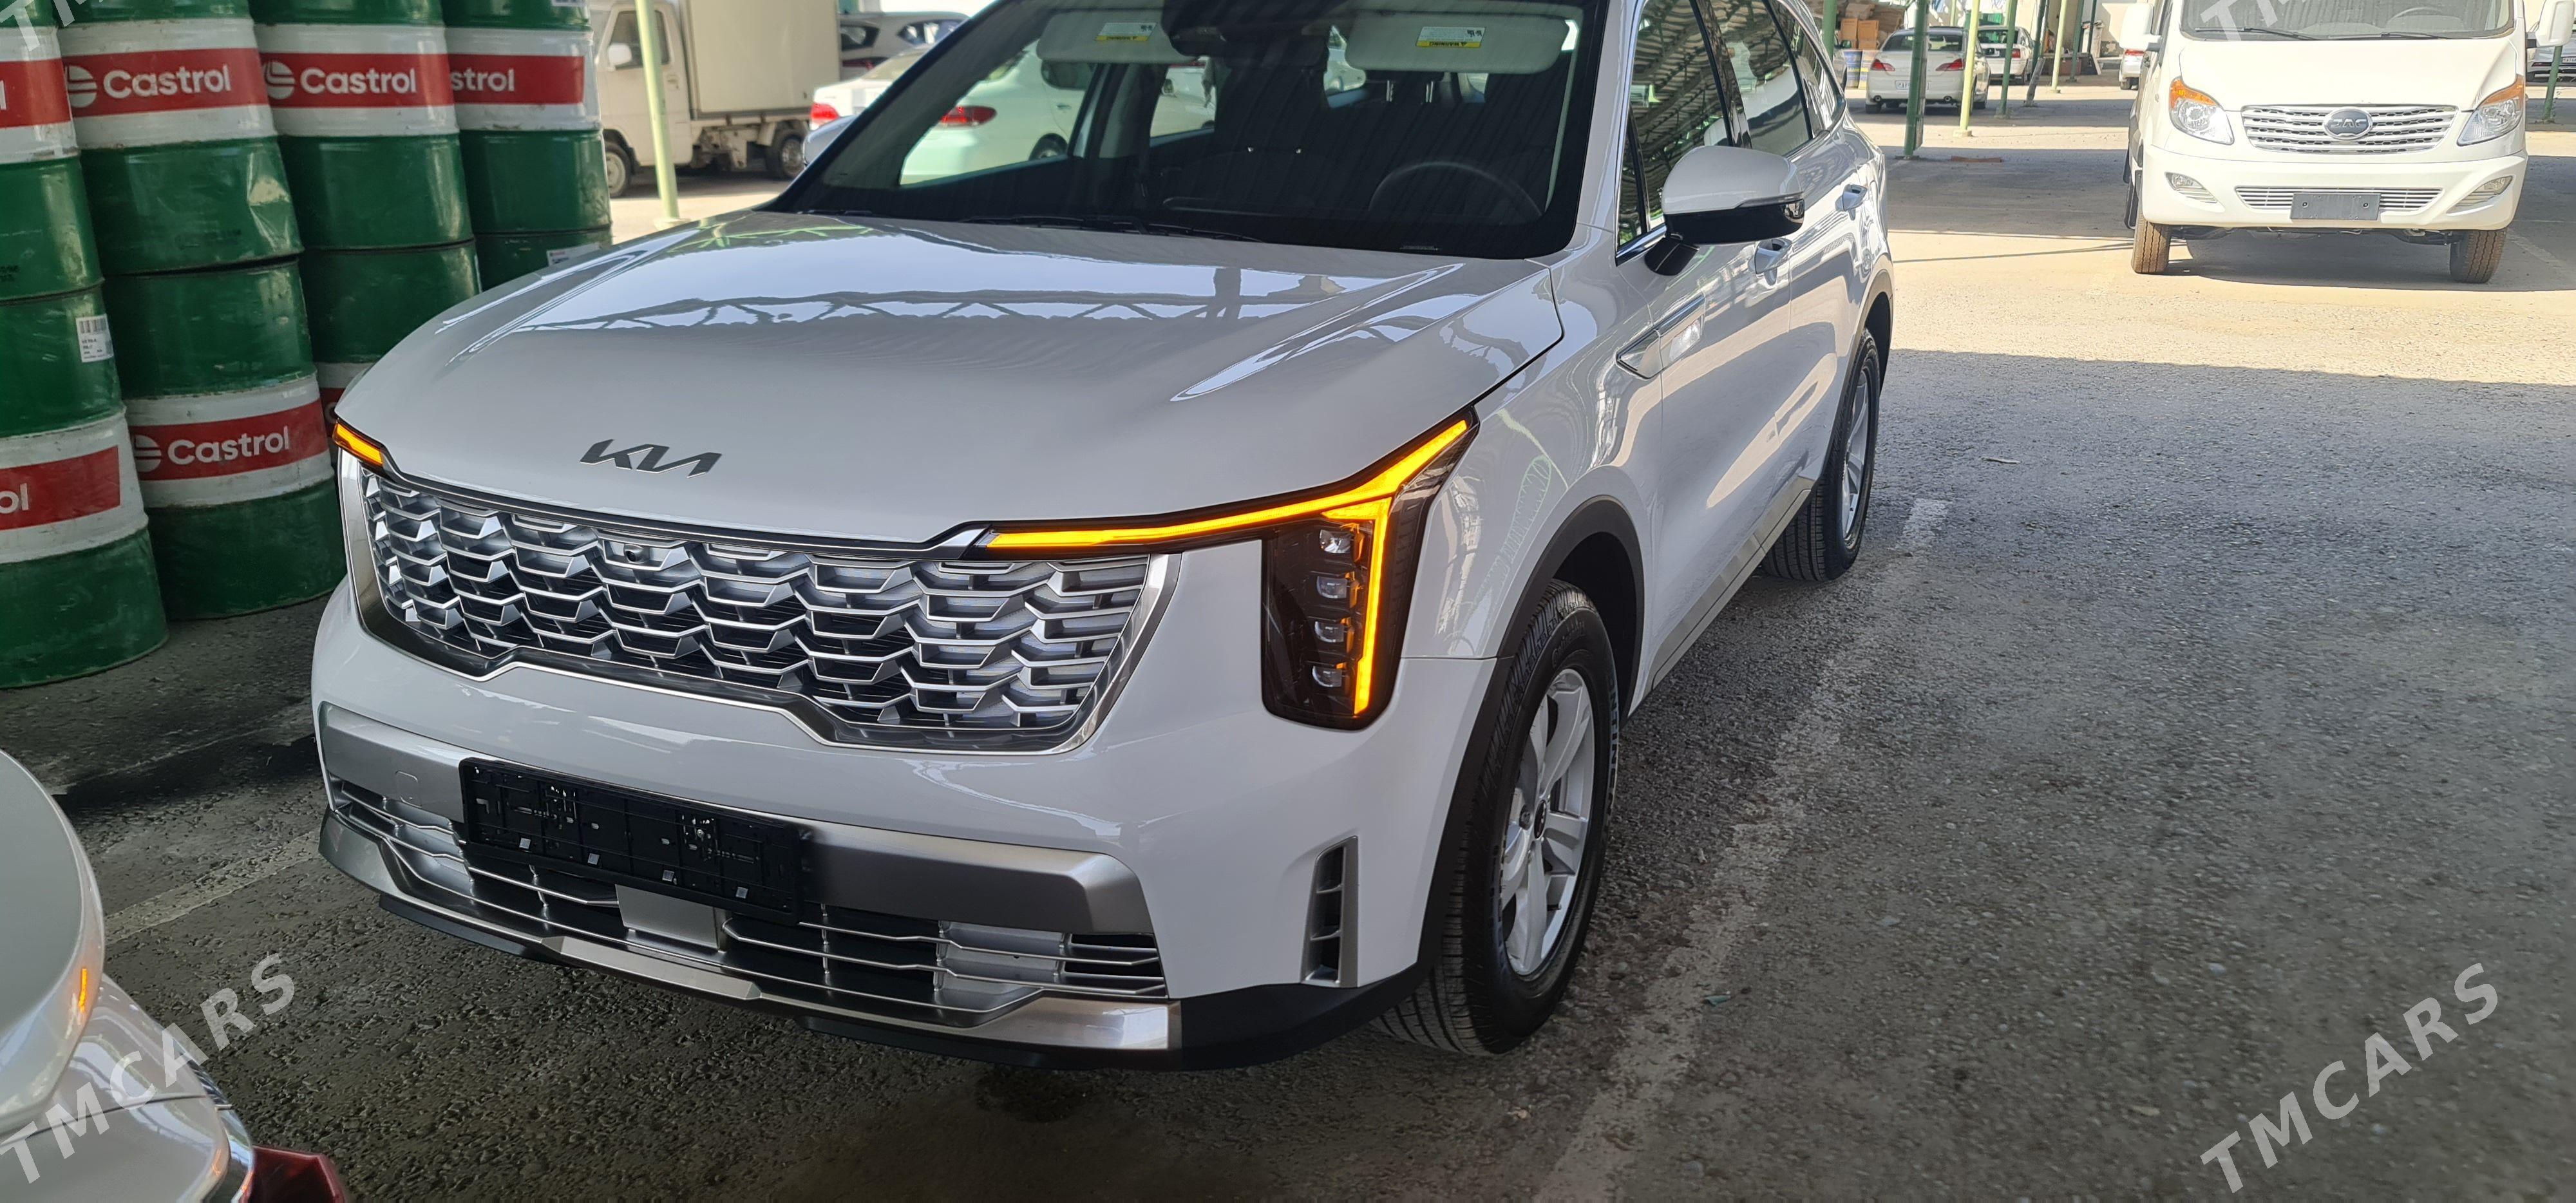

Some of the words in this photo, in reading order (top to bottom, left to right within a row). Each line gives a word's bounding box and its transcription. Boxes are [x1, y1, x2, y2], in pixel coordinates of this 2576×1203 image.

[103, 64, 231, 99] Castrol
[300, 68, 416, 95] Castrol
[450, 67, 515, 92] strol
[2331, 118, 2367, 128] JAC
[167, 425, 290, 465] Castrol
